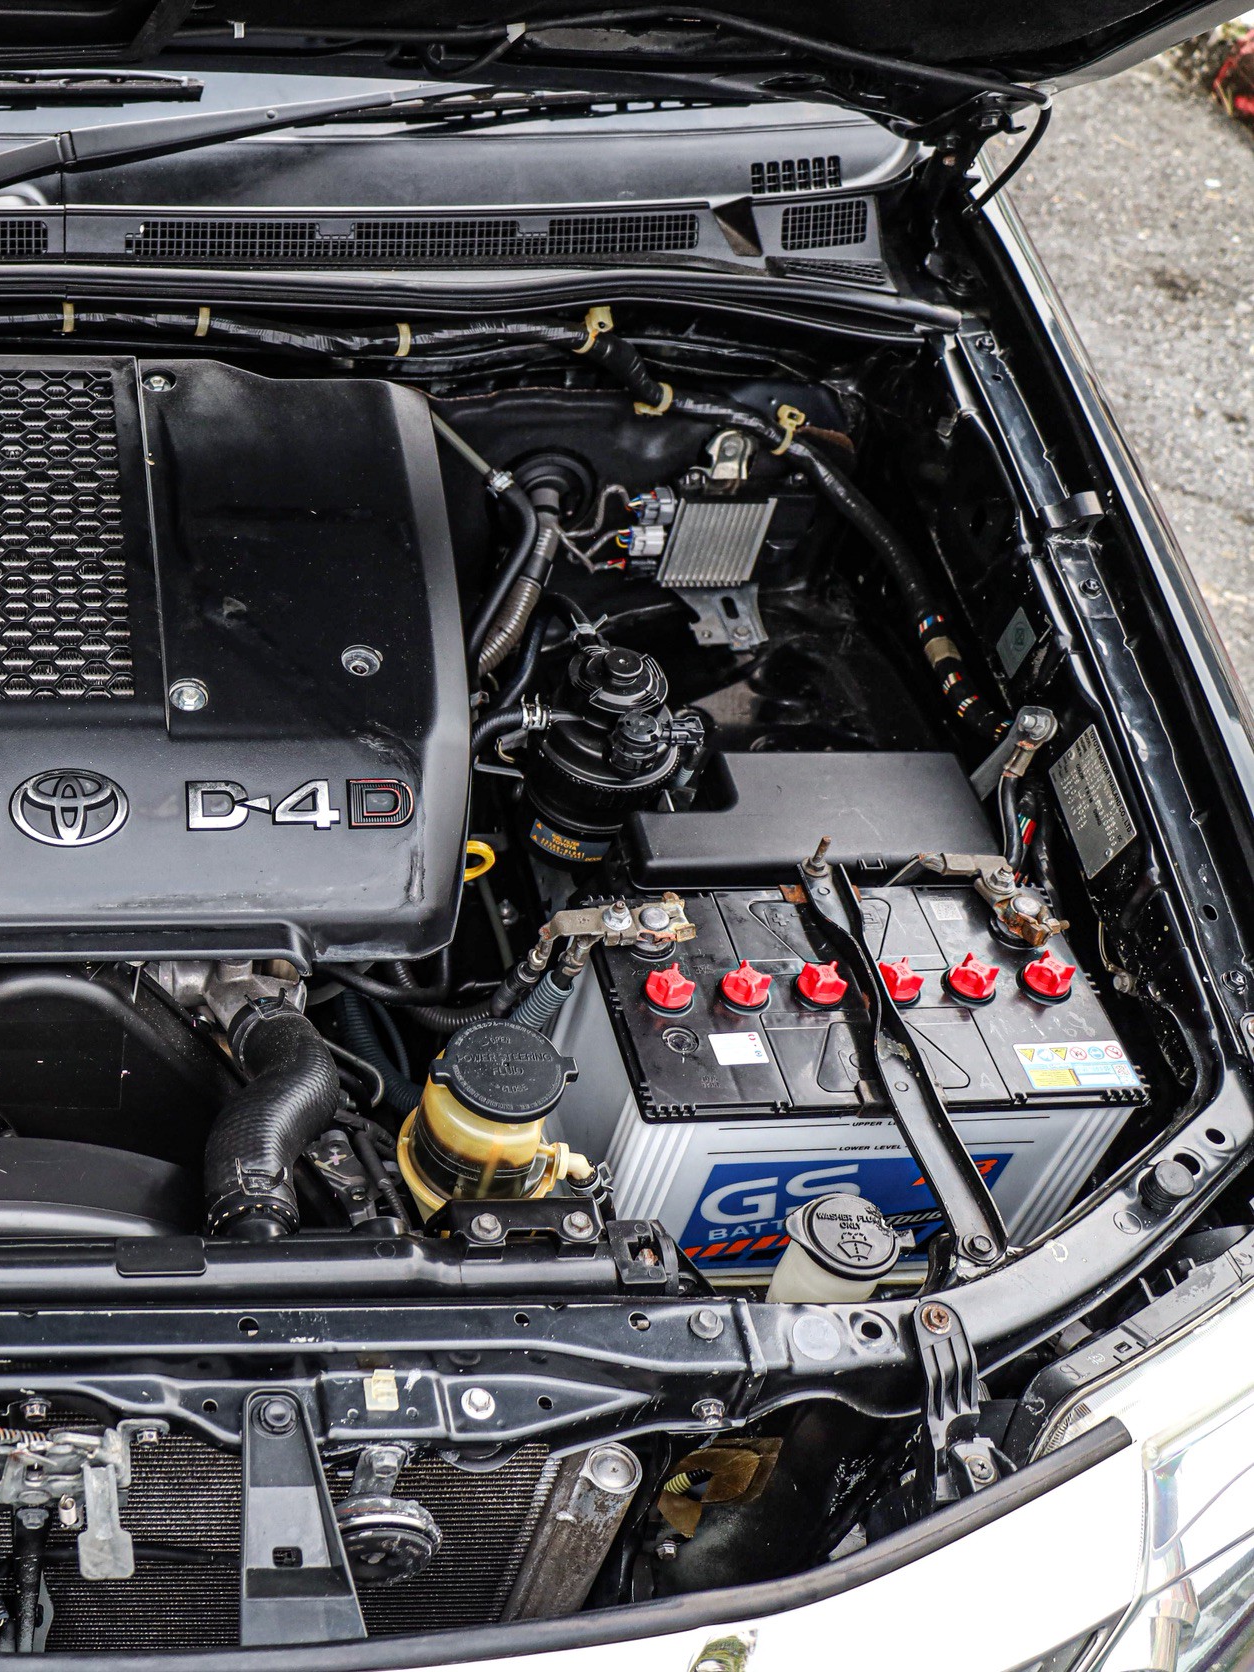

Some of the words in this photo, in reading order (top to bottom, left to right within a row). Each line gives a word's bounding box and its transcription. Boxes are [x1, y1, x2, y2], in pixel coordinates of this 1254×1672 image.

[1088, 729, 1100, 755] TOYOTA
[1097, 752, 1109, 776] MOTOR
[1106, 774, 1122, 807] THAILAND
[185, 778, 415, 831] D-4D
[552, 839, 577, 850] TOYOTA
[490, 1036, 511, 1044] OPEN
[456, 1053, 497, 1062] POWER
[498, 1053, 553, 1062] STEERING
[492, 1068, 524, 1076] FLUID
[501, 1084, 528, 1093] CLOSE
[699, 1163, 862, 1225] GS
[816, 1212, 852, 1222] WASHER
[885, 1210, 942, 1226] TOUG
[708, 1220, 786, 1241] BATT
